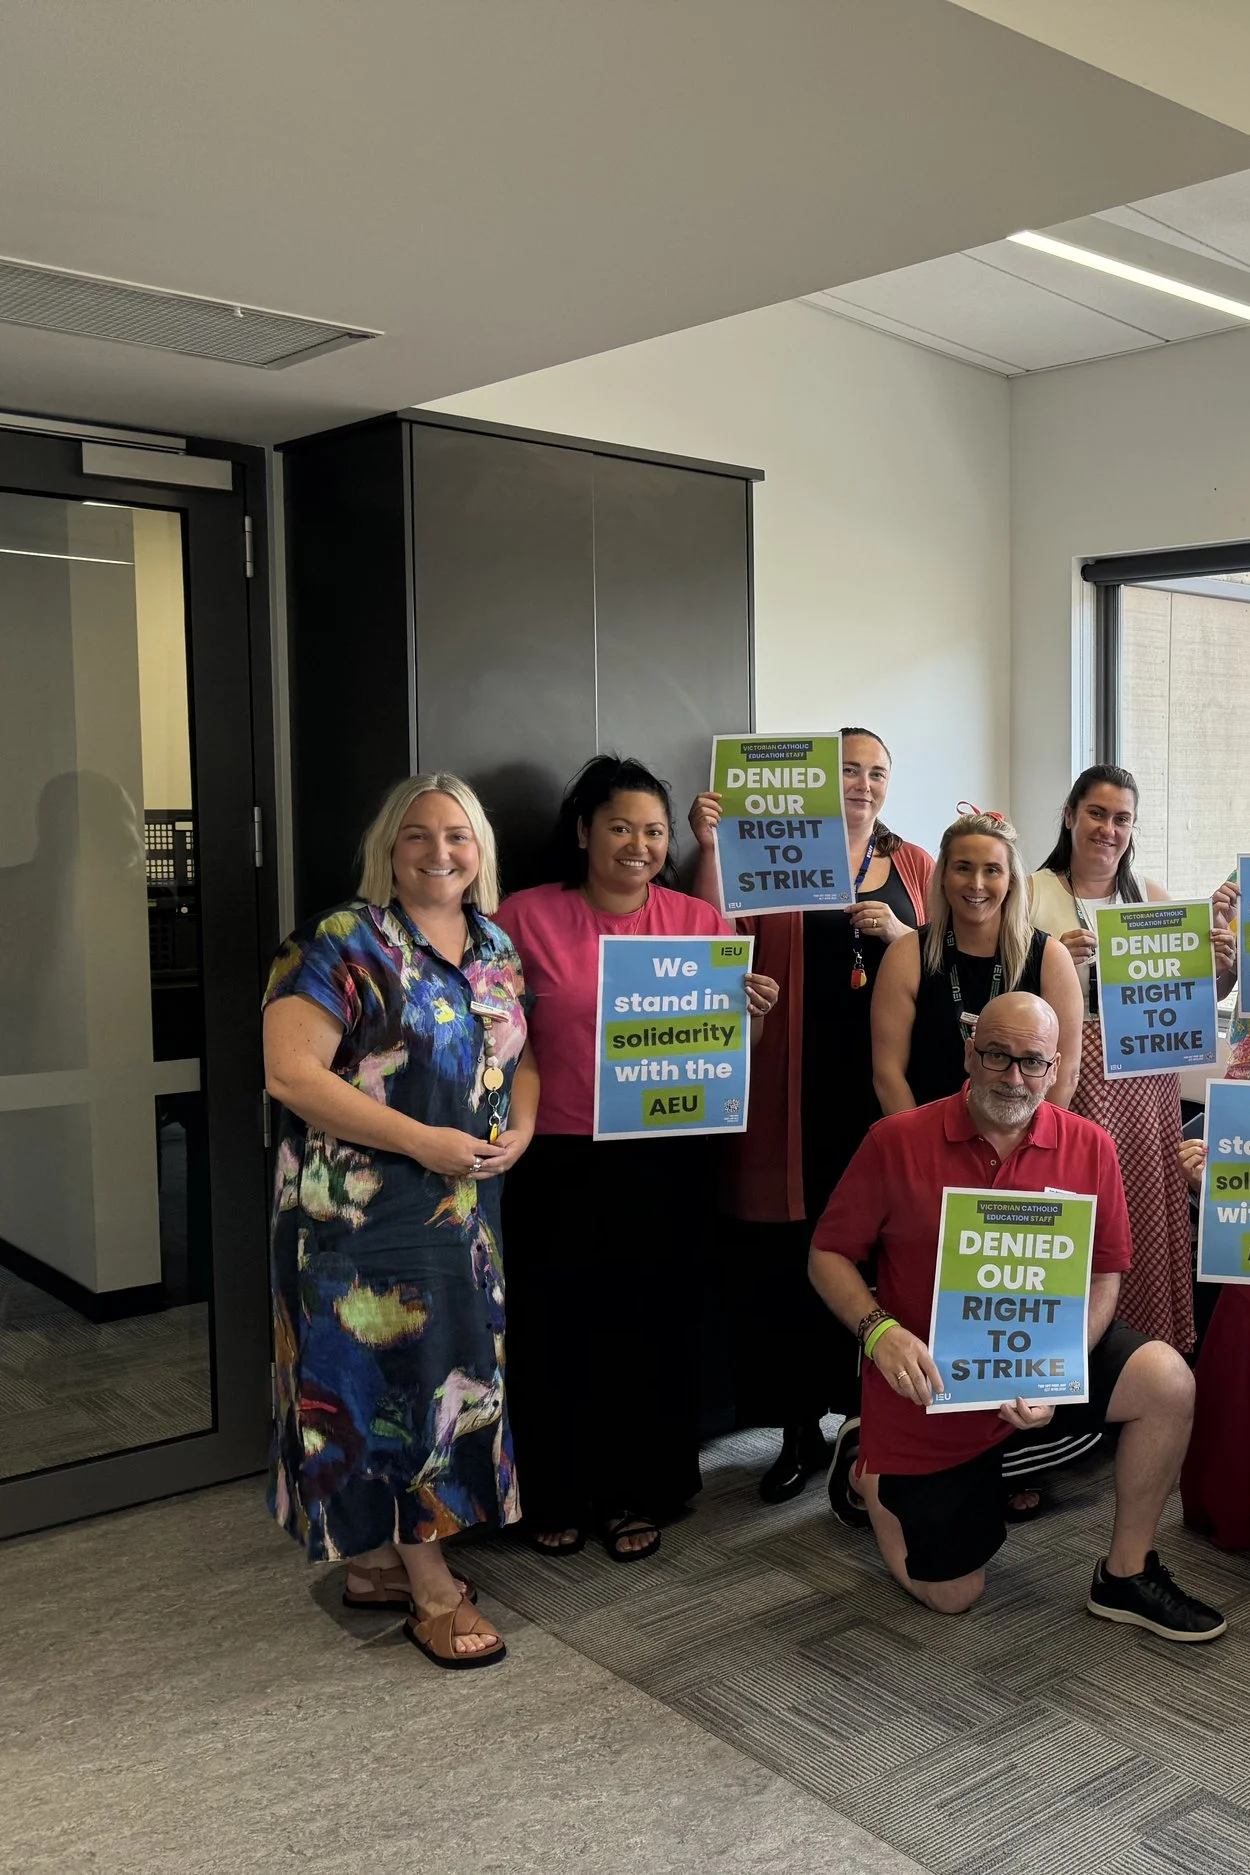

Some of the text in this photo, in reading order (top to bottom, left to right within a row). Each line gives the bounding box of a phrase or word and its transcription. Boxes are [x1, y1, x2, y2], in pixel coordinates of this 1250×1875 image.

[727, 768, 826, 788] DENIED
[745, 794, 804, 814] OUR
[738, 820, 822, 840] RIGHT
[764, 845, 802, 864] TO
[738, 870, 834, 892] STRIKE
[1129, 920, 1162, 928] EDUCATION
[721, 947, 742, 956] IEU
[1111, 932, 1200, 956] DENIED
[652, 958, 698, 978] We
[993, 964, 1002, 980] IEU
[1128, 959, 1180, 979] OUR
[614, 988, 730, 1012] stand in
[952, 986, 962, 1002] IEU
[1121, 982, 1195, 1004] RIGHT
[1144, 1008, 1176, 1028] TO
[612, 1022, 735, 1049] solidarity
[1120, 1030, 1202, 1056] STRIKE
[614, 1058, 732, 1082] with the
[649, 1095, 698, 1116] AEU
[980, 1204, 1020, 1212] VICTORIAN
[986, 1214, 1029, 1222] EDUCATION
[959, 1230, 1074, 1260] DENIED
[977, 1264, 1046, 1290] OUR
[962, 1296, 1061, 1323] RIGHT
[988, 1330, 1032, 1352] TO
[952, 1358, 1065, 1380] STRIKE
